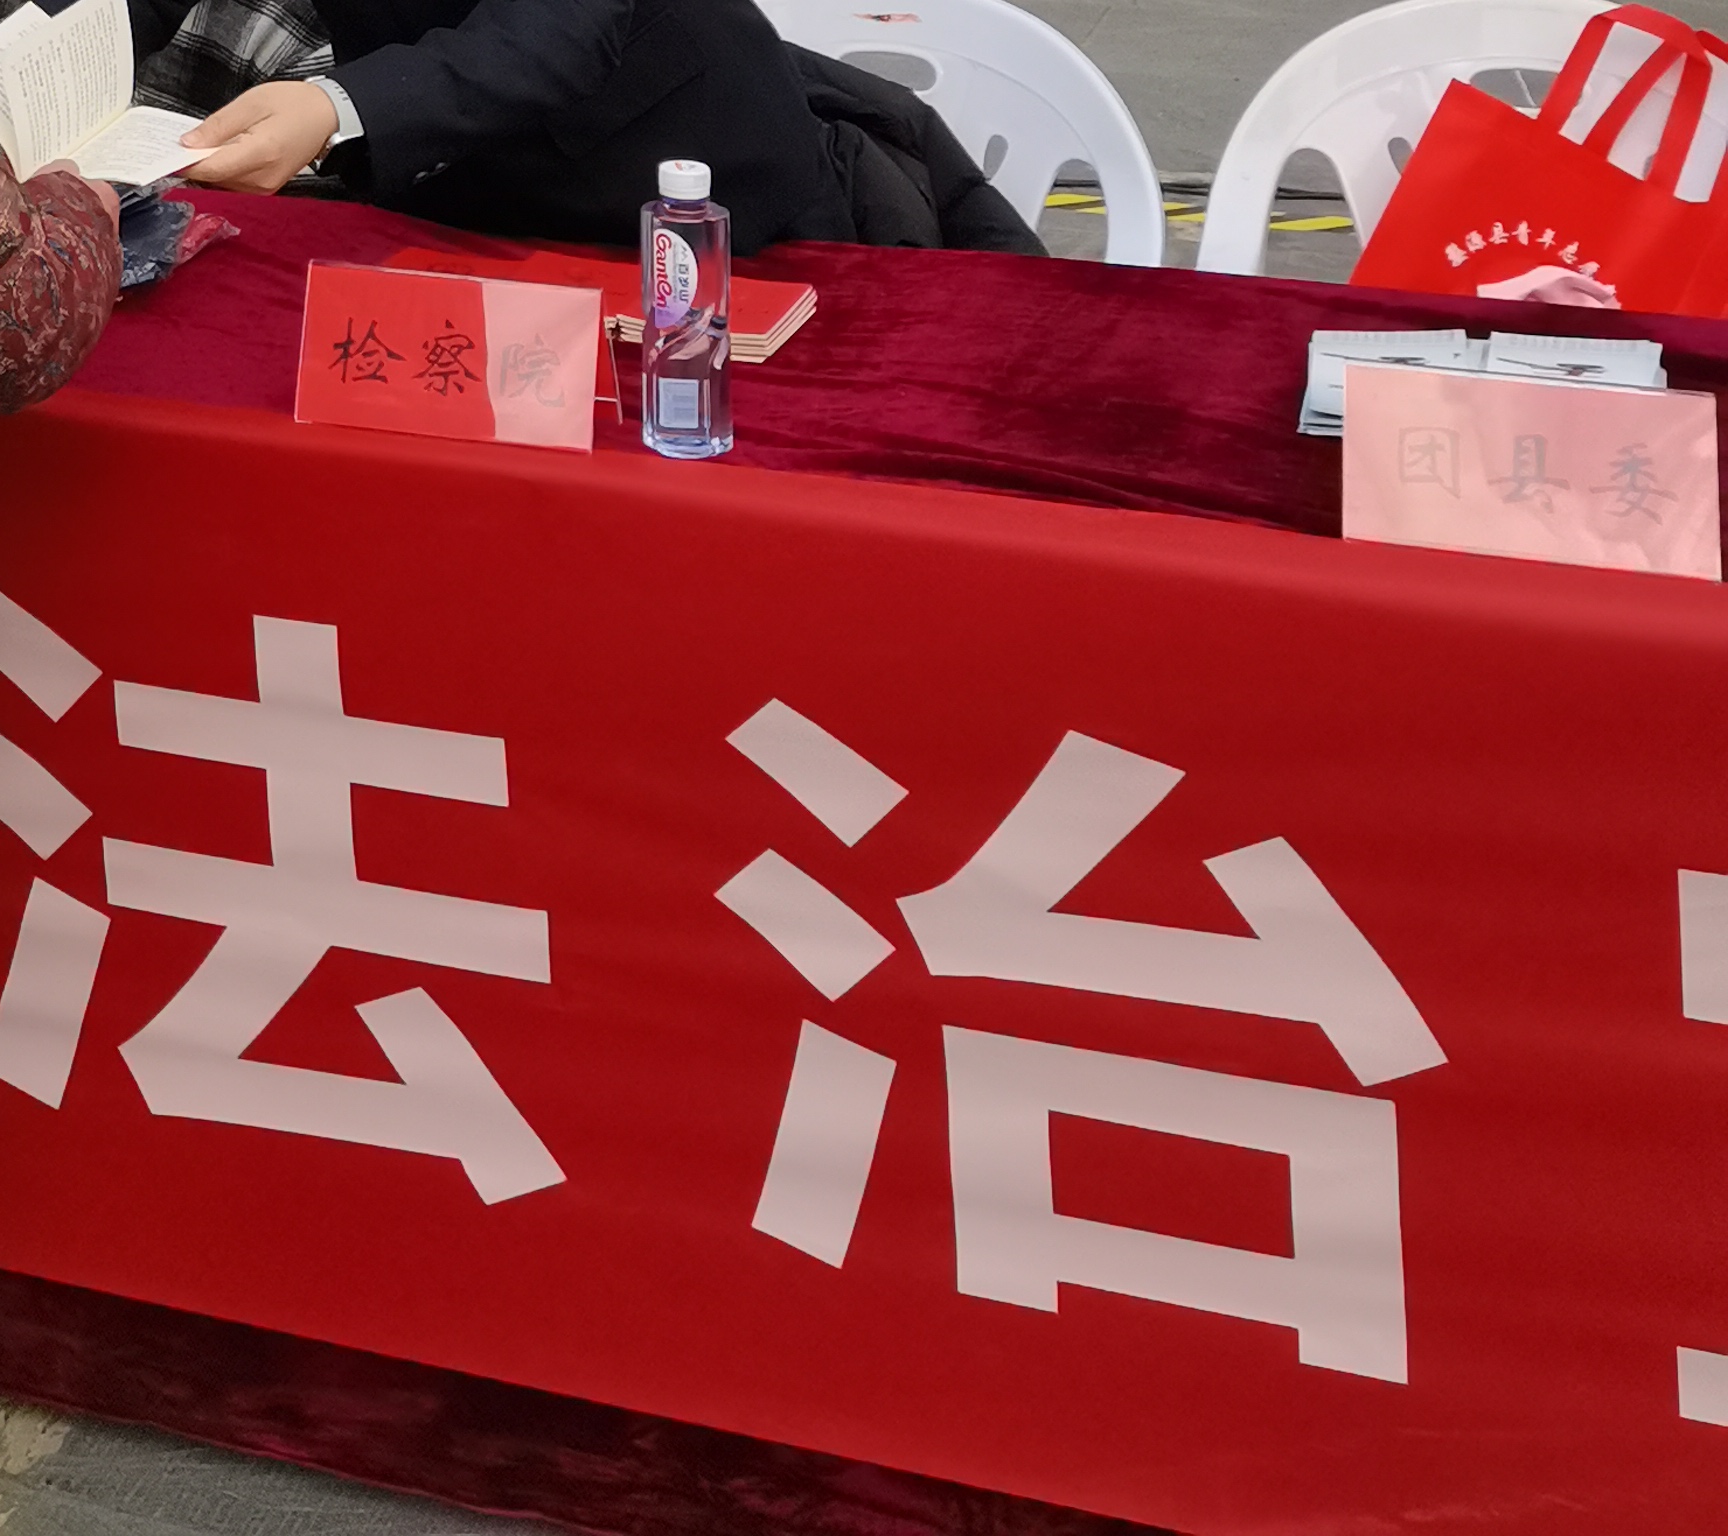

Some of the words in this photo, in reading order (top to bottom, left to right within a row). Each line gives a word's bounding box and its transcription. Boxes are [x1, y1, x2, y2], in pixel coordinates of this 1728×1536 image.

[328, 316, 569, 410] 检察院
[1398, 425, 1678, 524] 团县委
